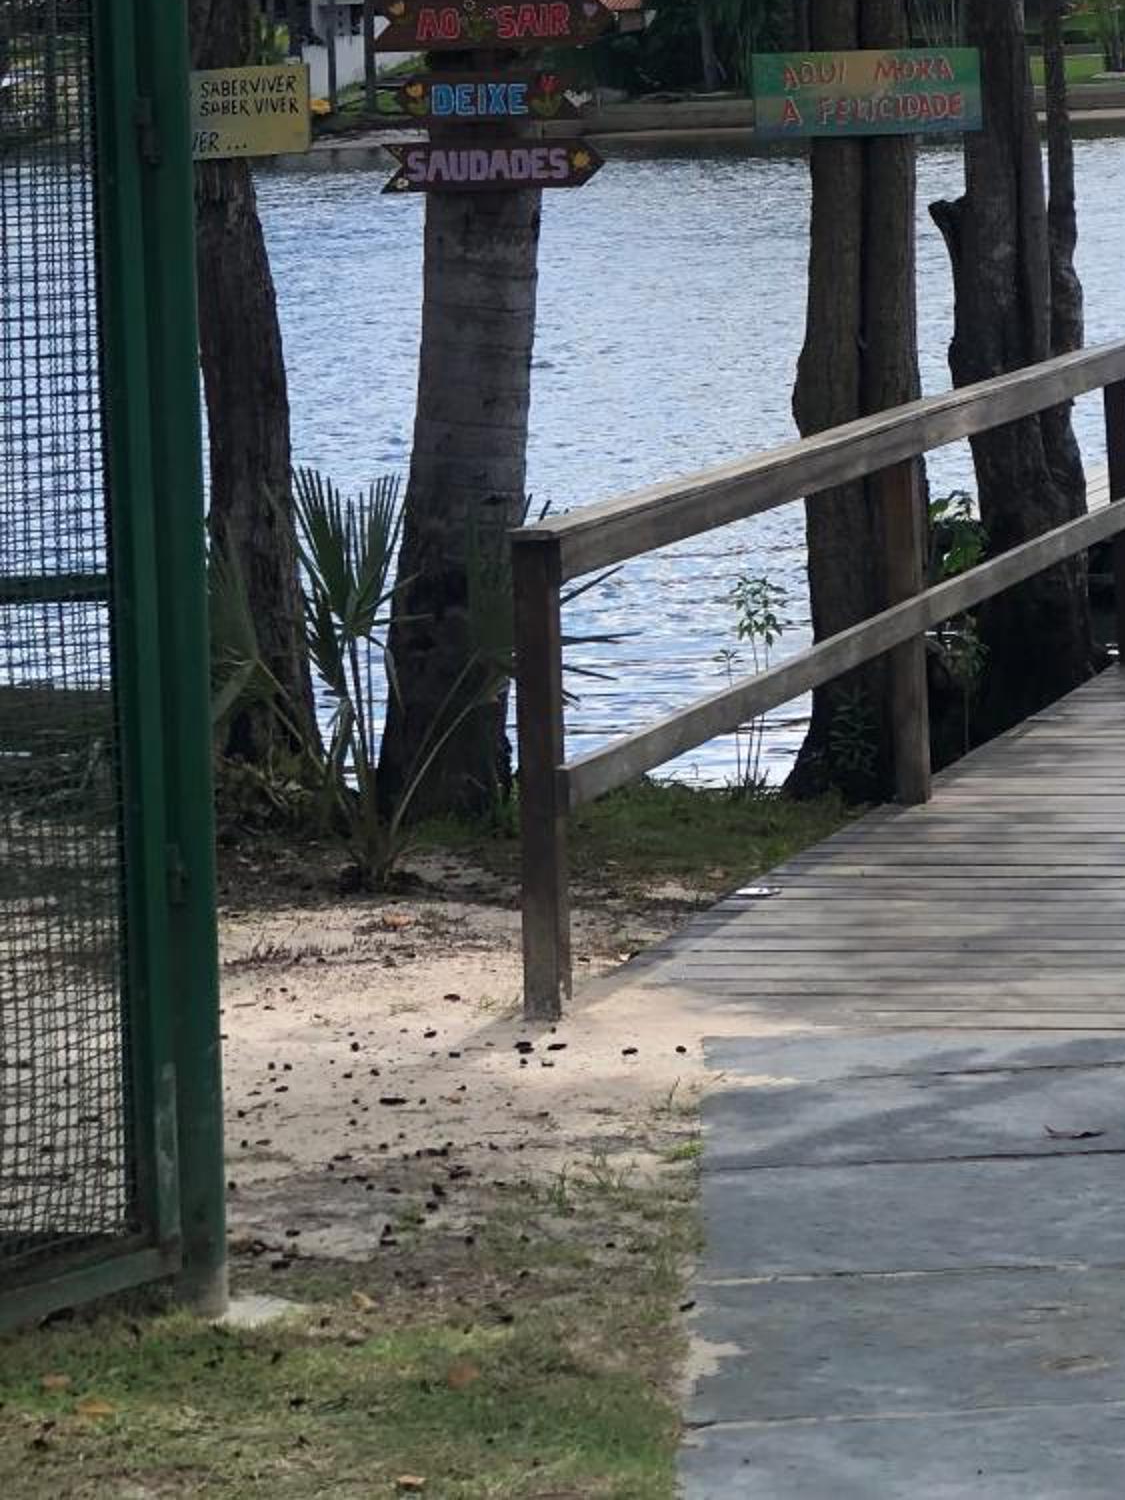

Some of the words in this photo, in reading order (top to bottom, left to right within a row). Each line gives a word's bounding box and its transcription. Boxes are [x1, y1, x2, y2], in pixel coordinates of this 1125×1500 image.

[416, 8, 460, 40] AO
[496, 3, 571, 37] SAIR
[783, 58, 848, 91] AQUI
[874, 54, 955, 83] MORA
[200, 100, 251, 117] SABER
[254, 98, 299, 115] VIVER
[431, 83, 529, 116] DEIXE
[782, 96, 803, 126] A
[817, 92, 963, 125] FELICIDADE
[406, 148, 570, 183] SAUDADES
